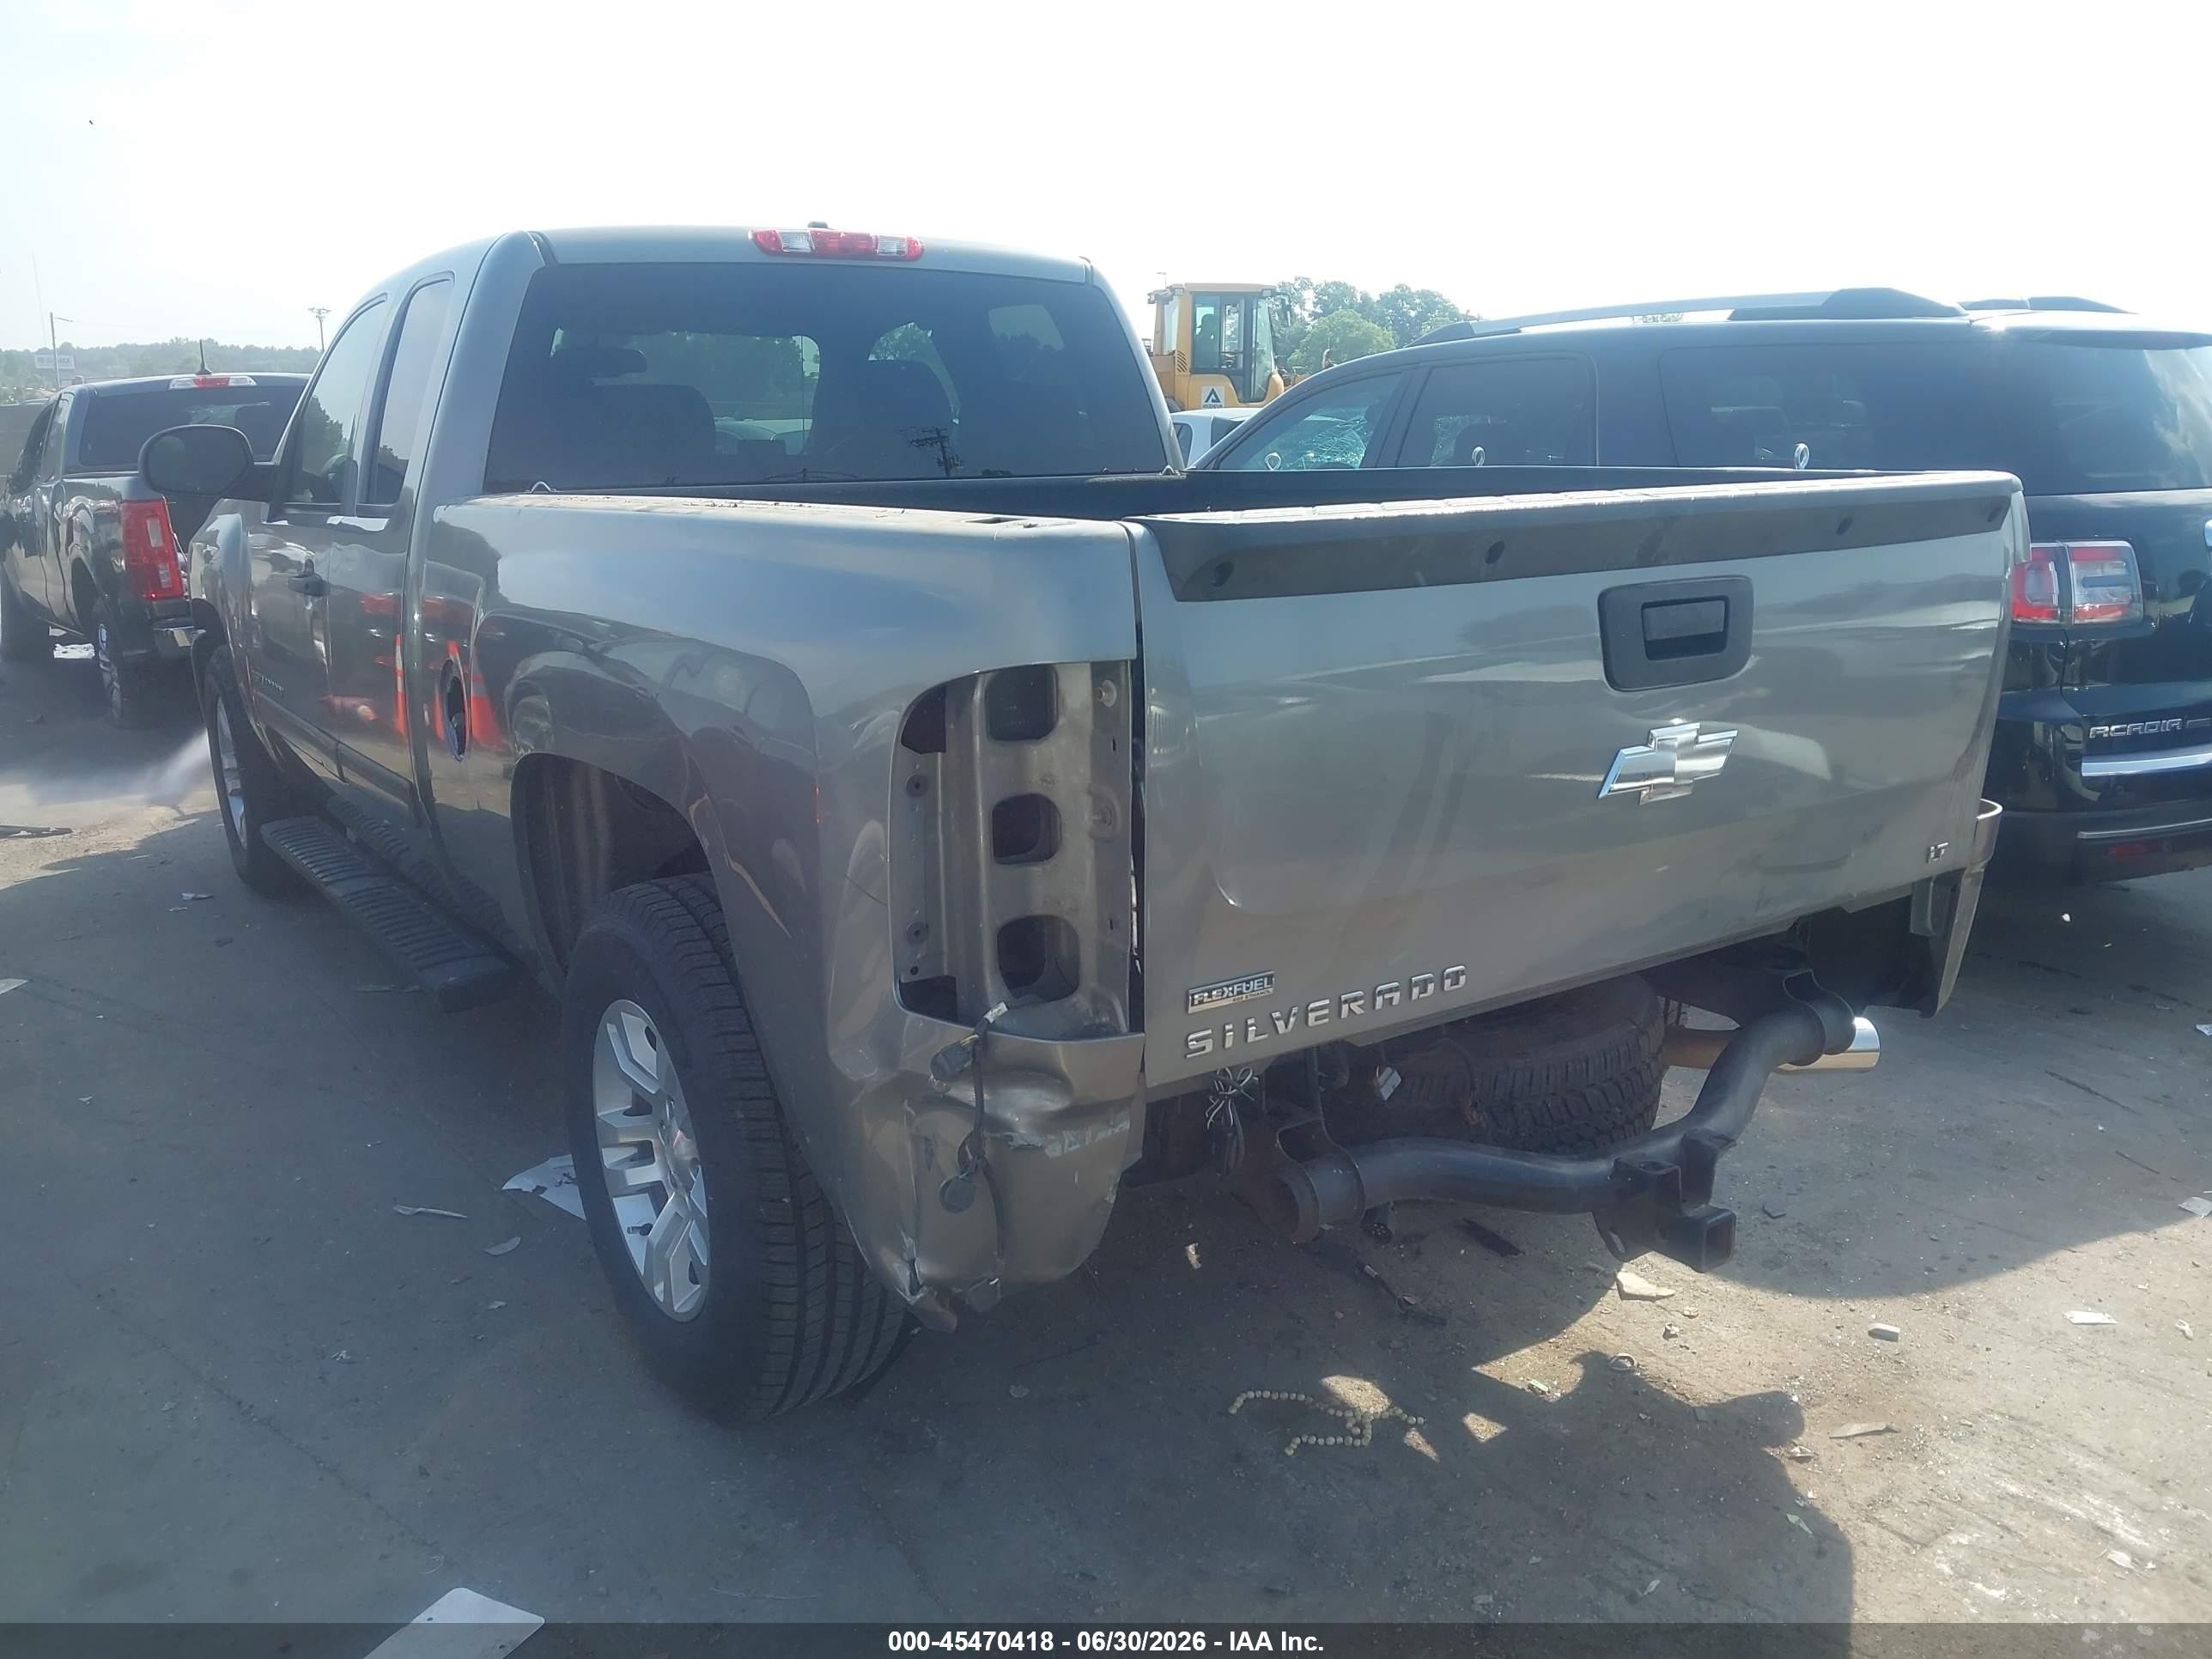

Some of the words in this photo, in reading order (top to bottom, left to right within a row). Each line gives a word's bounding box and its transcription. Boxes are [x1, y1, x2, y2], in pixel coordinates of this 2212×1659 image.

[2089, 719, 2182, 738] ACADIA
[1929, 842, 1949, 865] LT
[1194, 976, 1272, 1006] FLEXFUEL
[1184, 964, 1467, 1059] SILVERADO
